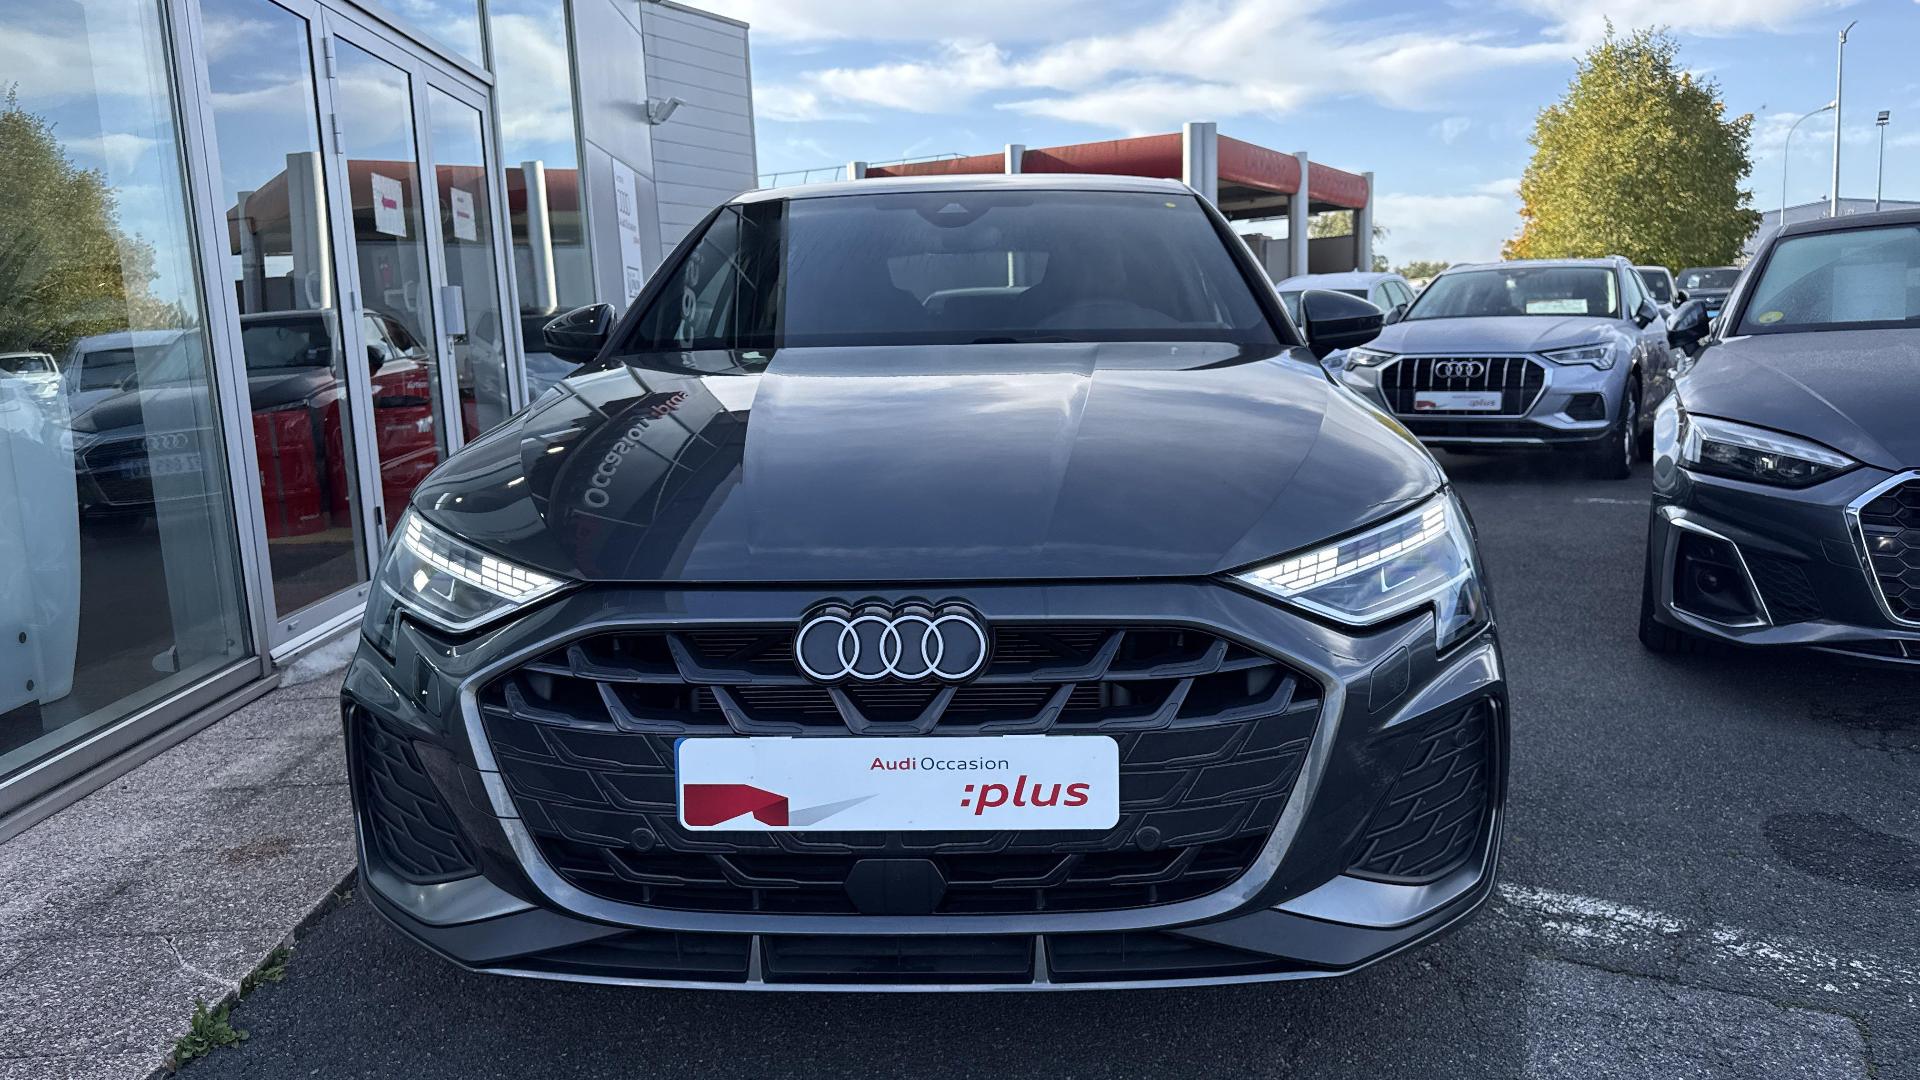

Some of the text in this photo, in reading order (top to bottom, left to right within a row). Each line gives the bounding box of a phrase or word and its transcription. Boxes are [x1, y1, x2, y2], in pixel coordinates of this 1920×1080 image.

[870, 757, 1009, 771] Audi Occasion
[961, 774, 1090, 816] :plus
